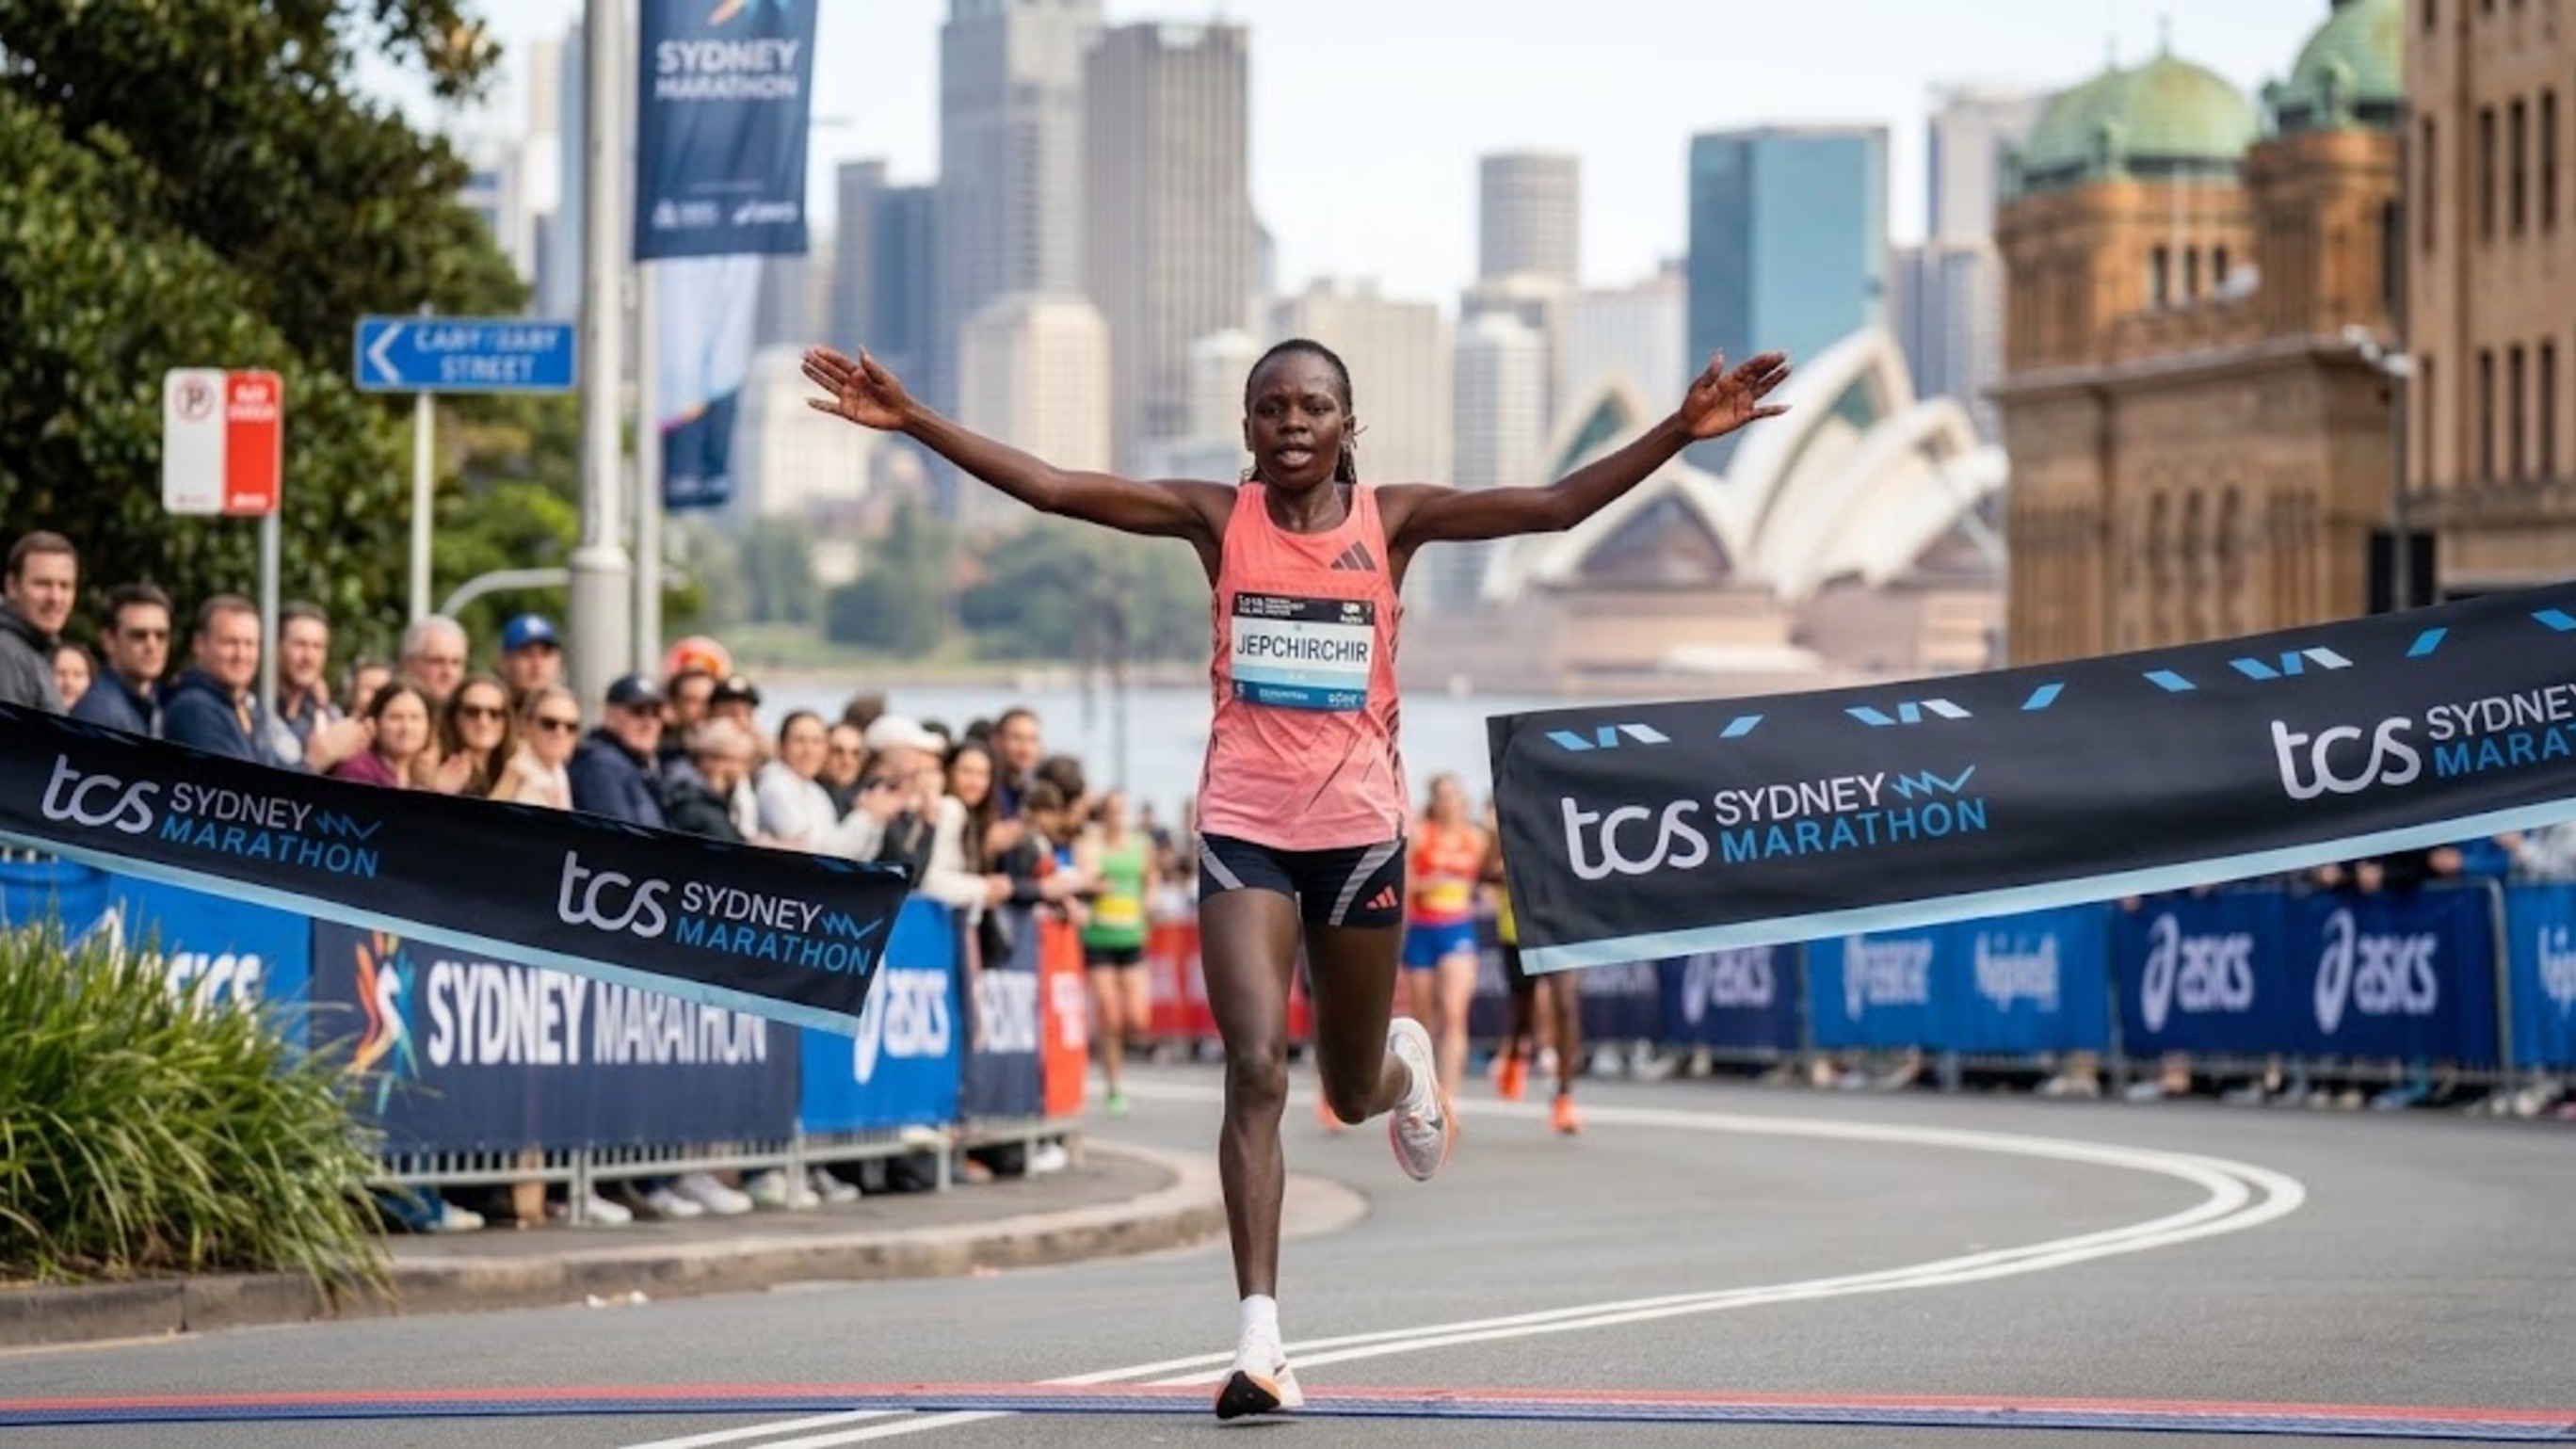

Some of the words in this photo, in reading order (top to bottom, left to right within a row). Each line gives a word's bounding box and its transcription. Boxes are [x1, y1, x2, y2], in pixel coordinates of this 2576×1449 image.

[656, 40, 800, 74] SYDNEY
[441, 354, 535, 383] STREET
[1236, 635, 1368, 663] JEPCHIRCHIR
[2271, 716, 2423, 800] tcs
[2426, 684, 2576, 741] SYDNE
[41, 754, 160, 833] tcs
[169, 781, 313, 832] SYDNEY
[1561, 797, 1709, 880] tcs
[1713, 771, 1885, 827] SYDNEY
[160, 815, 379, 878] MARATHON
[1720, 797, 1988, 863] MARATHON
[557, 850, 670, 938] tcs
[681, 881, 823, 933] SYDNEY
[675, 916, 871, 975] MARATHON
[427, 959, 586, 1067] SYDNEY
